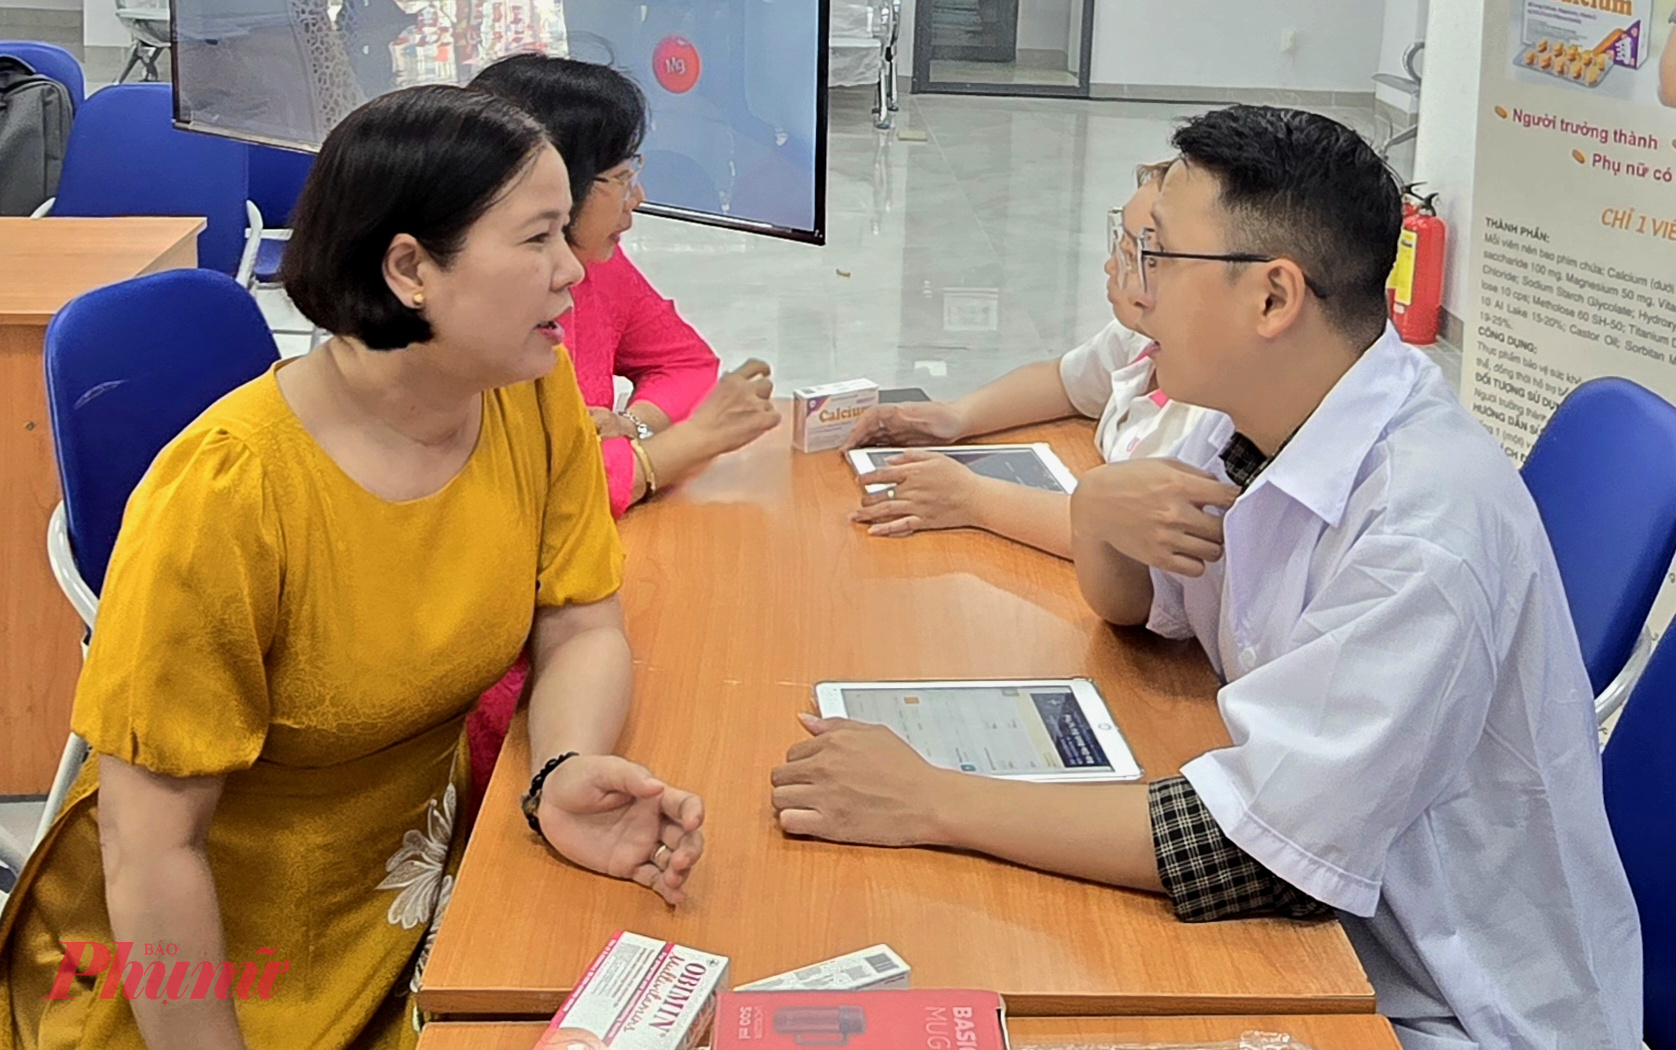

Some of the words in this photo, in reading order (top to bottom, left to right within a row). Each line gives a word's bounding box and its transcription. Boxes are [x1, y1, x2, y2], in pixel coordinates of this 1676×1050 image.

[665, 56, 686, 75] Mg
[1512, 108, 1556, 129] Người
[1560, 118, 1608, 144] trưởng
[1613, 128, 1658, 150] thành
[1592, 153, 1621, 176] Phụ
[1626, 162, 1650, 178] nữ
[1653, 167, 1673, 183] có
[1485, 216, 1518, 234] THÀNH
[1601, 206, 1636, 230] CHỈ
[1636, 215, 1647, 234] 1
[1522, 275, 1554, 294] Sodium
[1531, 262, 1546, 275] 100
[1566, 272, 1619, 297] Magnesium
[1620, 288, 1634, 300] 50
[1607, 266, 1648, 287] Calcium
[1478, 326, 1505, 342] CÔNG
[1569, 324, 1600, 341] Castor
[1624, 340, 1665, 361] Sorbitan
[1628, 323, 1669, 345] Titanium
[648, 962, 707, 1033] OBIMIN
[924, 1006, 951, 1050] MUG
